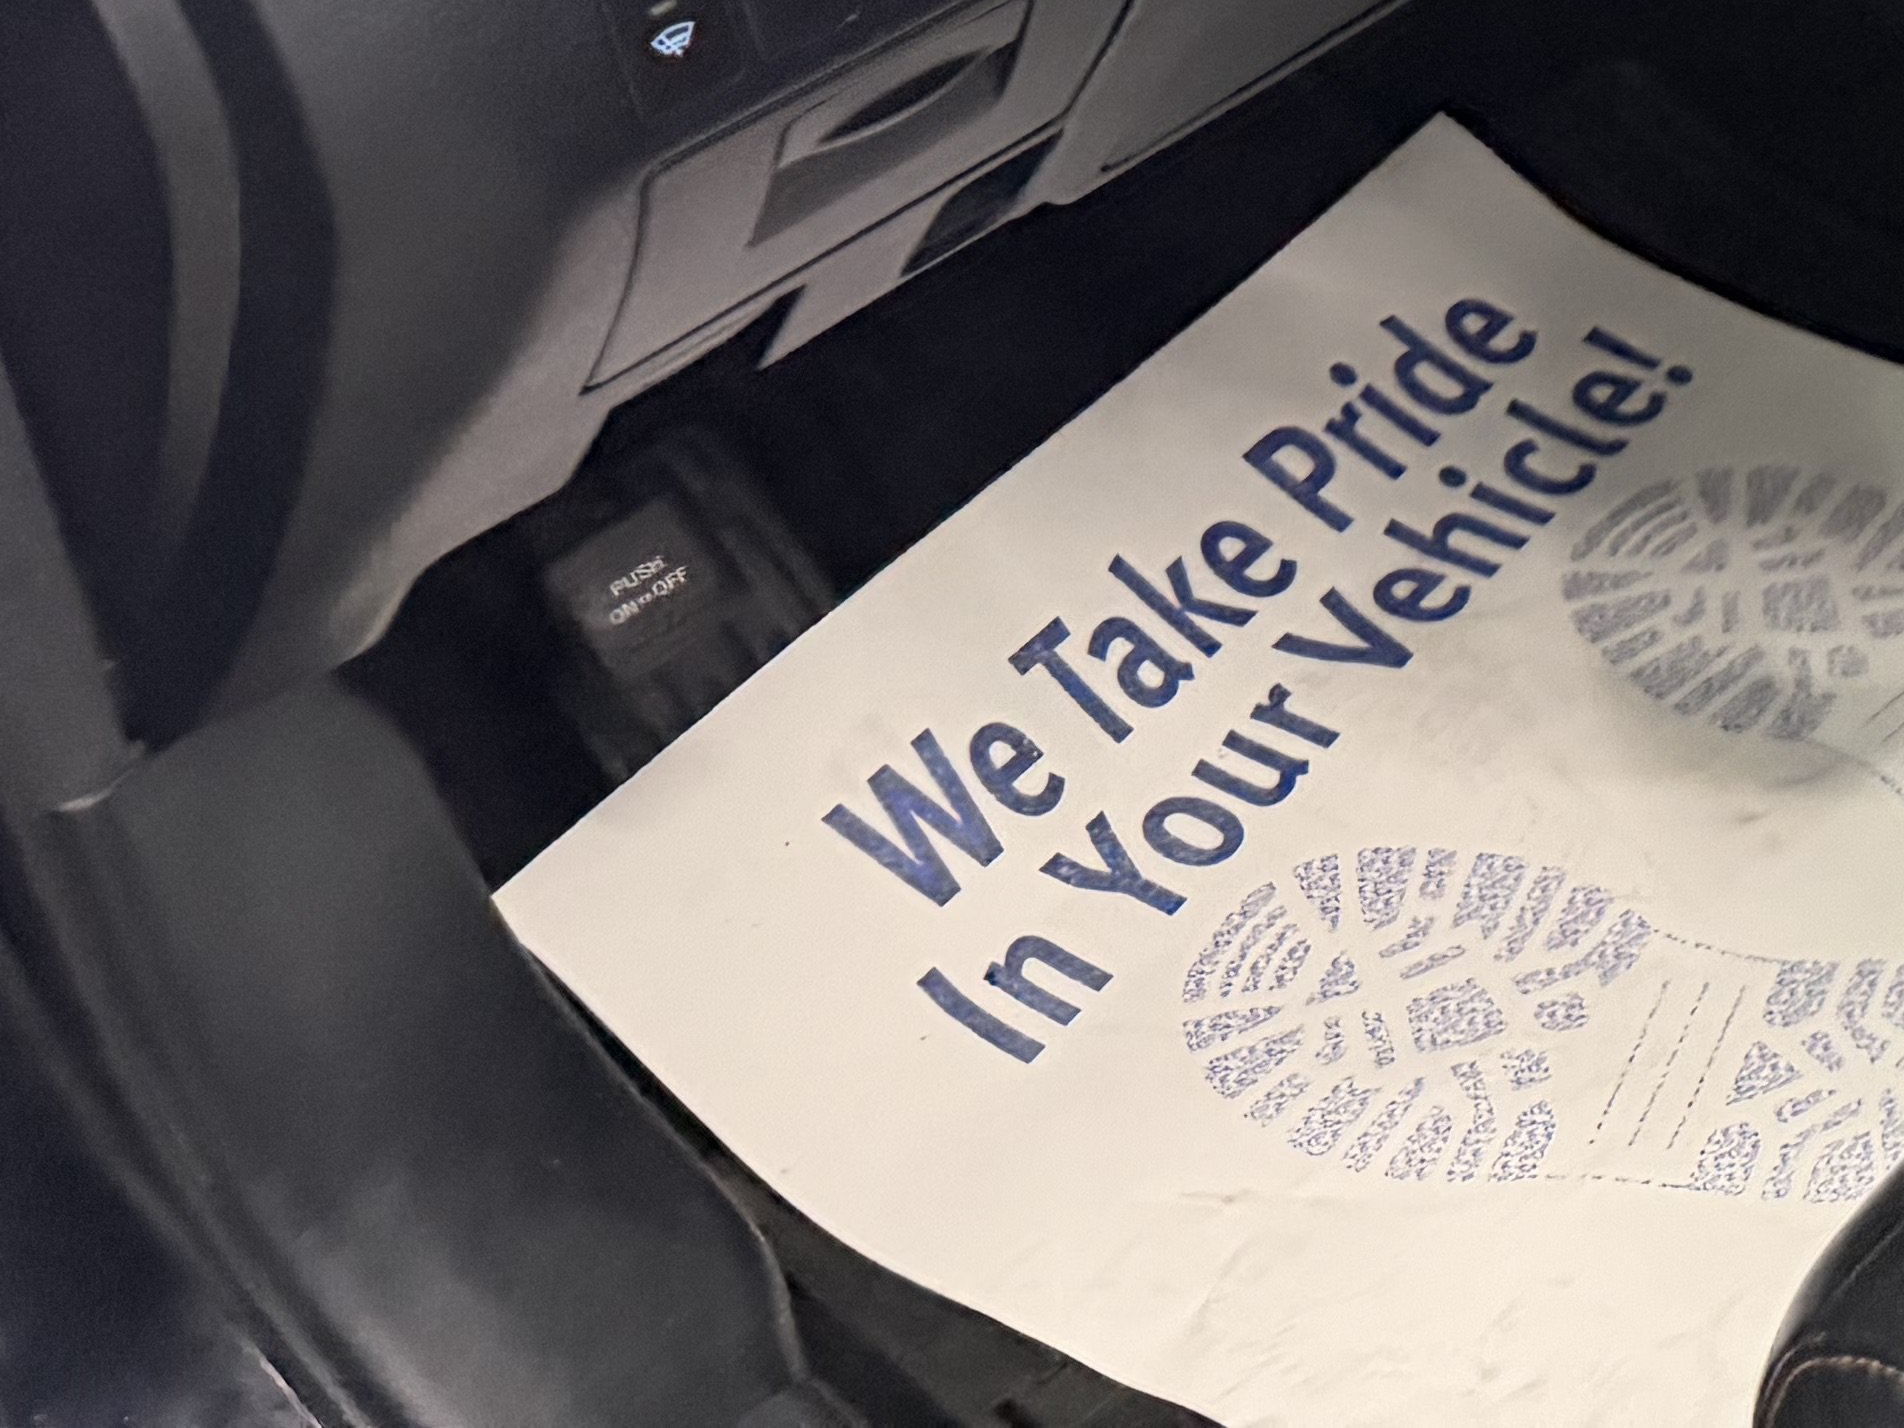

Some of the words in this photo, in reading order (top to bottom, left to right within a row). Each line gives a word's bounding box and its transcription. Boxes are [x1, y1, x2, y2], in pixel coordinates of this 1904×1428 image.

[609, 555, 665, 597] PUSH
[650, 565, 689, 597] OFF
[821, 718, 1066, 909] We
[1007, 516, 1298, 744] Take
[1241, 295, 1539, 534] Pride
[916, 932, 1114, 1065] In
[1038, 681, 1341, 918] Your
[1270, 325, 1695, 671] Vehicle!
